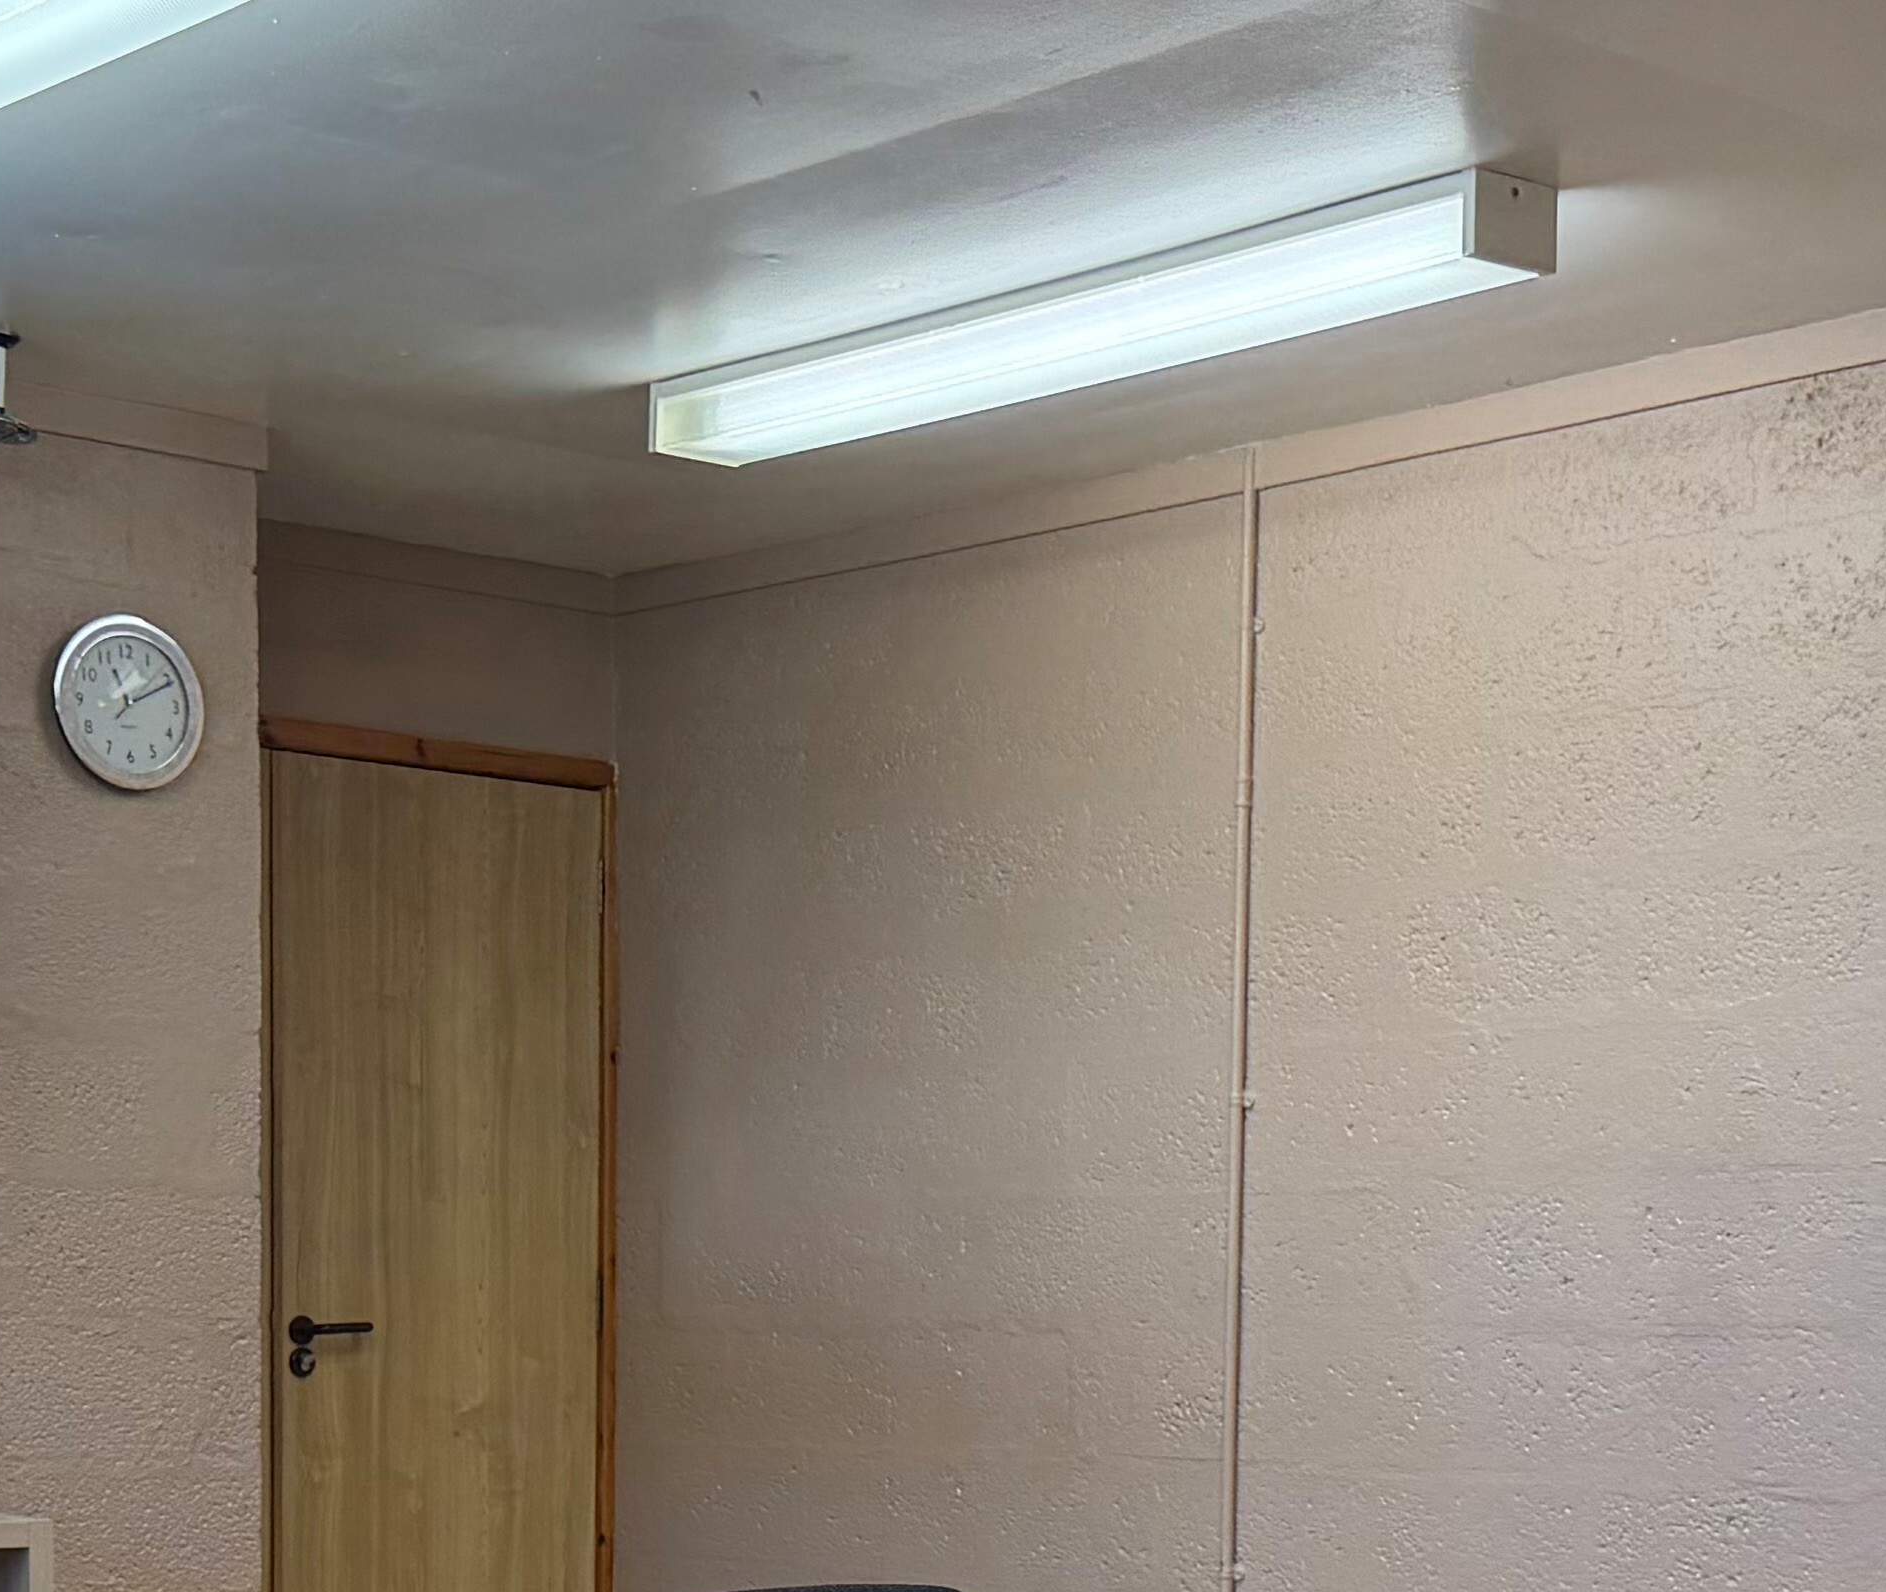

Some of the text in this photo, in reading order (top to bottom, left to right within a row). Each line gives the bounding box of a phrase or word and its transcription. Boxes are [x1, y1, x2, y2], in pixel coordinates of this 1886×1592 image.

[98, 651, 111, 664] 11
[119, 644, 133, 659] 12
[145, 653, 151, 666] 1
[82, 668, 97, 682] 10
[75, 692, 84, 705] 9
[173, 701, 180, 715] 3
[85, 720, 93, 734] 8
[166, 728, 173, 741] 4
[106, 740, 113, 755] 7
[149, 744, 157, 759] 5
[126, 750, 135, 763] 6
